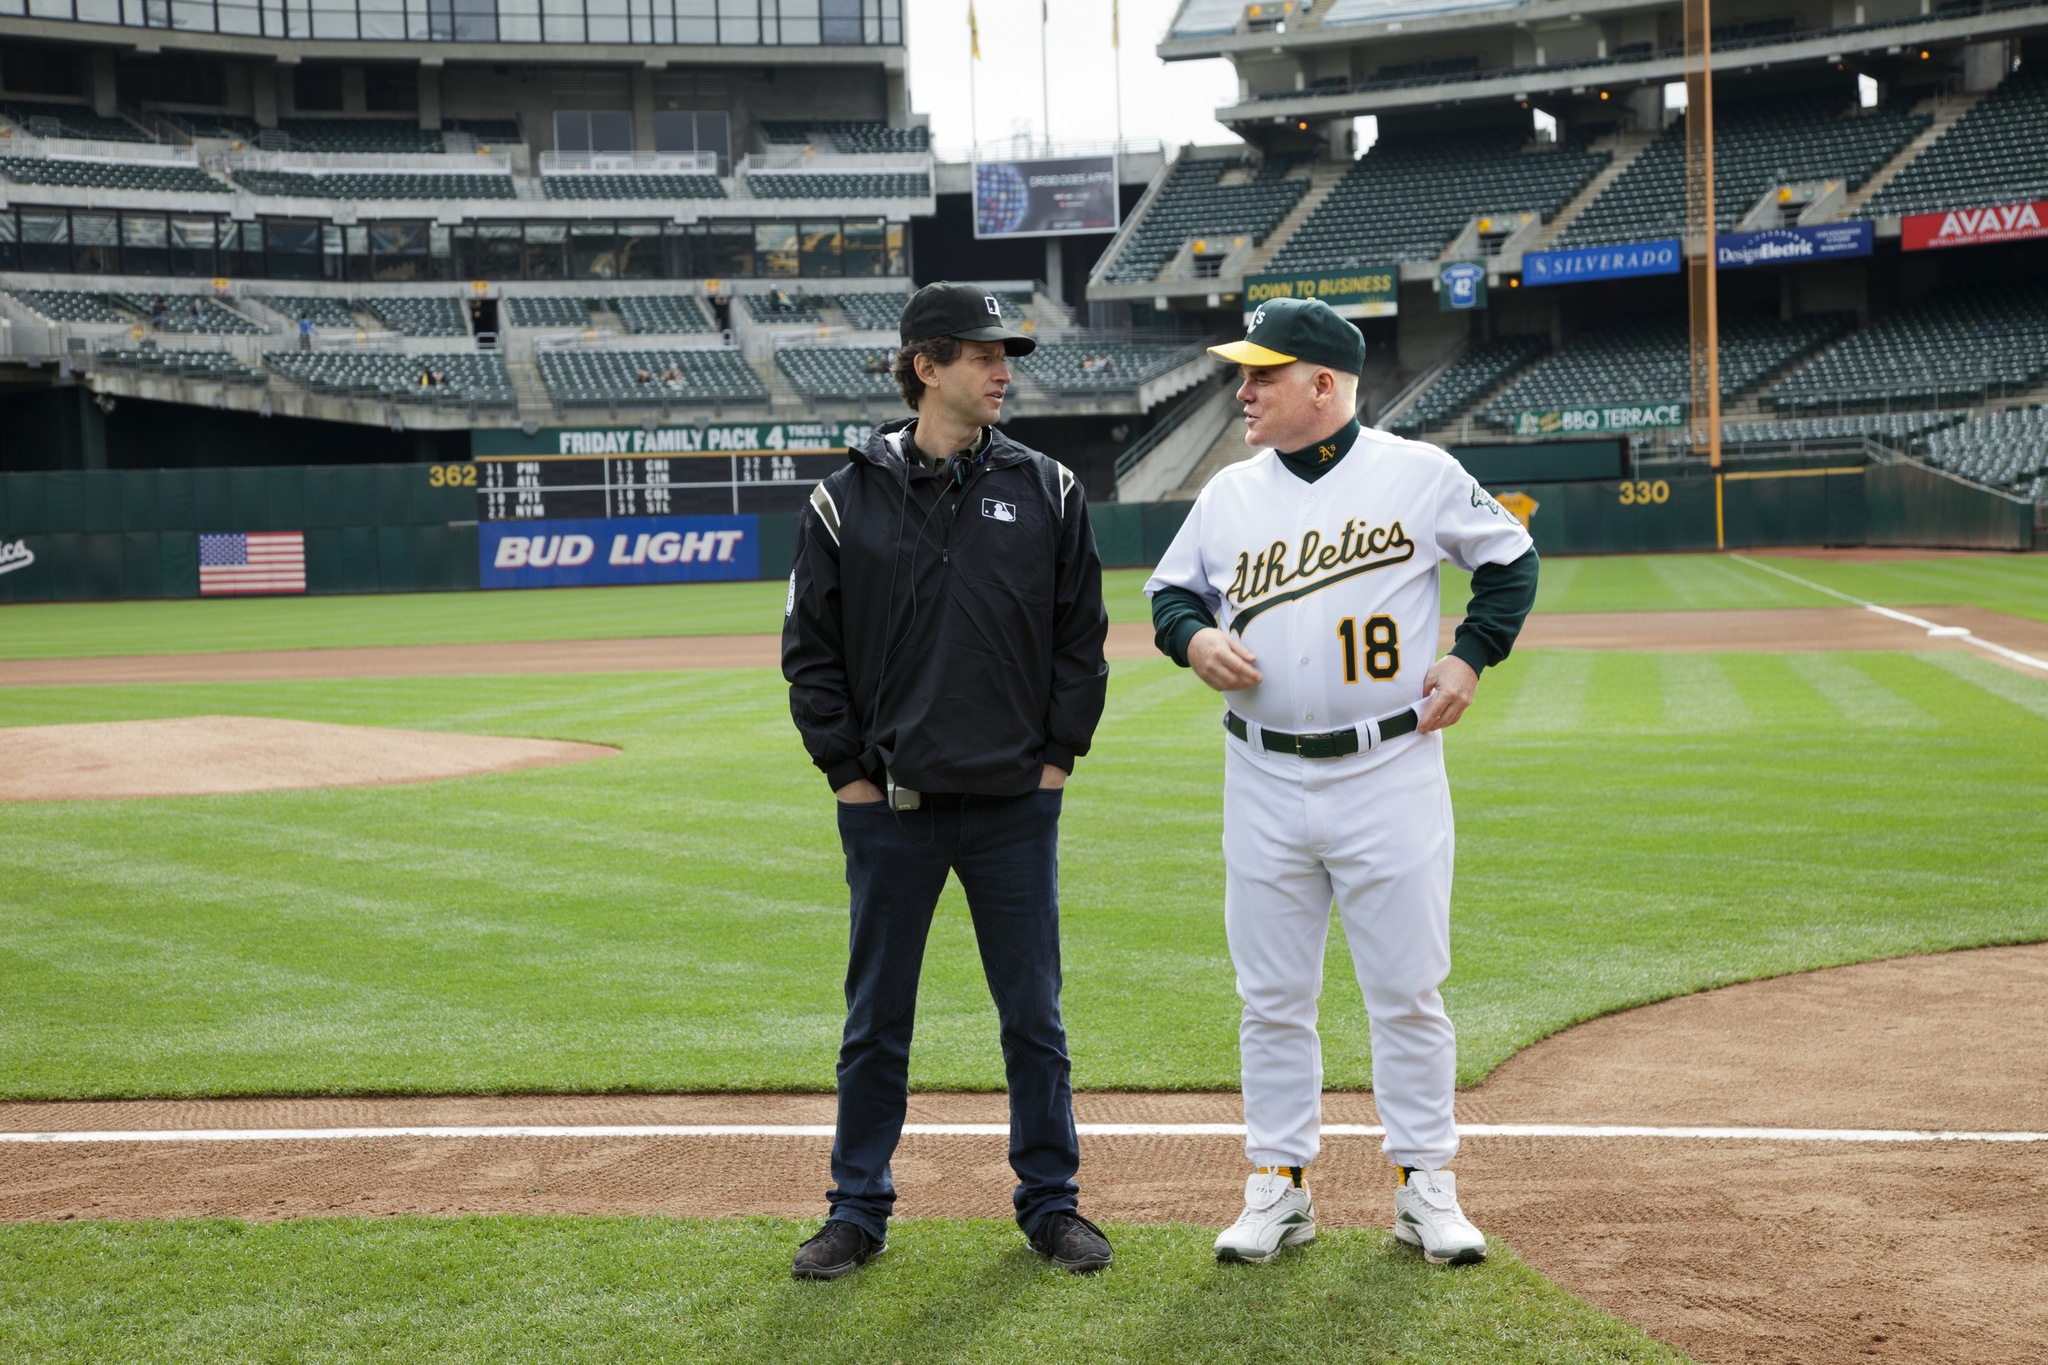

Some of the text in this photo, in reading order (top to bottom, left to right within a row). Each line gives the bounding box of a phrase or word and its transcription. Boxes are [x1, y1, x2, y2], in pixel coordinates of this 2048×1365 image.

[1938, 204, 2041, 238] AVAYA
[1553, 248, 1673, 276] SILVERADO
[1247, 274, 1392, 300] DOWN TO BUSINESS
[1454, 278, 1471, 297] 42
[787, 424, 839, 437] TICKETS
[1562, 409, 1599, 431] BBQ
[1602, 405, 1681, 429] TERRACE
[559, 425, 785, 454] FRIDAY FAMILY PACK 4
[786, 438, 831, 450] MEALS
[429, 464, 477, 488] 362
[516, 462, 540, 475] PHI
[1618, 480, 1670, 506] 330
[494, 530, 744, 569] BUD LIGHT
[1226, 516, 1415, 636] Athletics
[1337, 613, 1401, 685] 18
